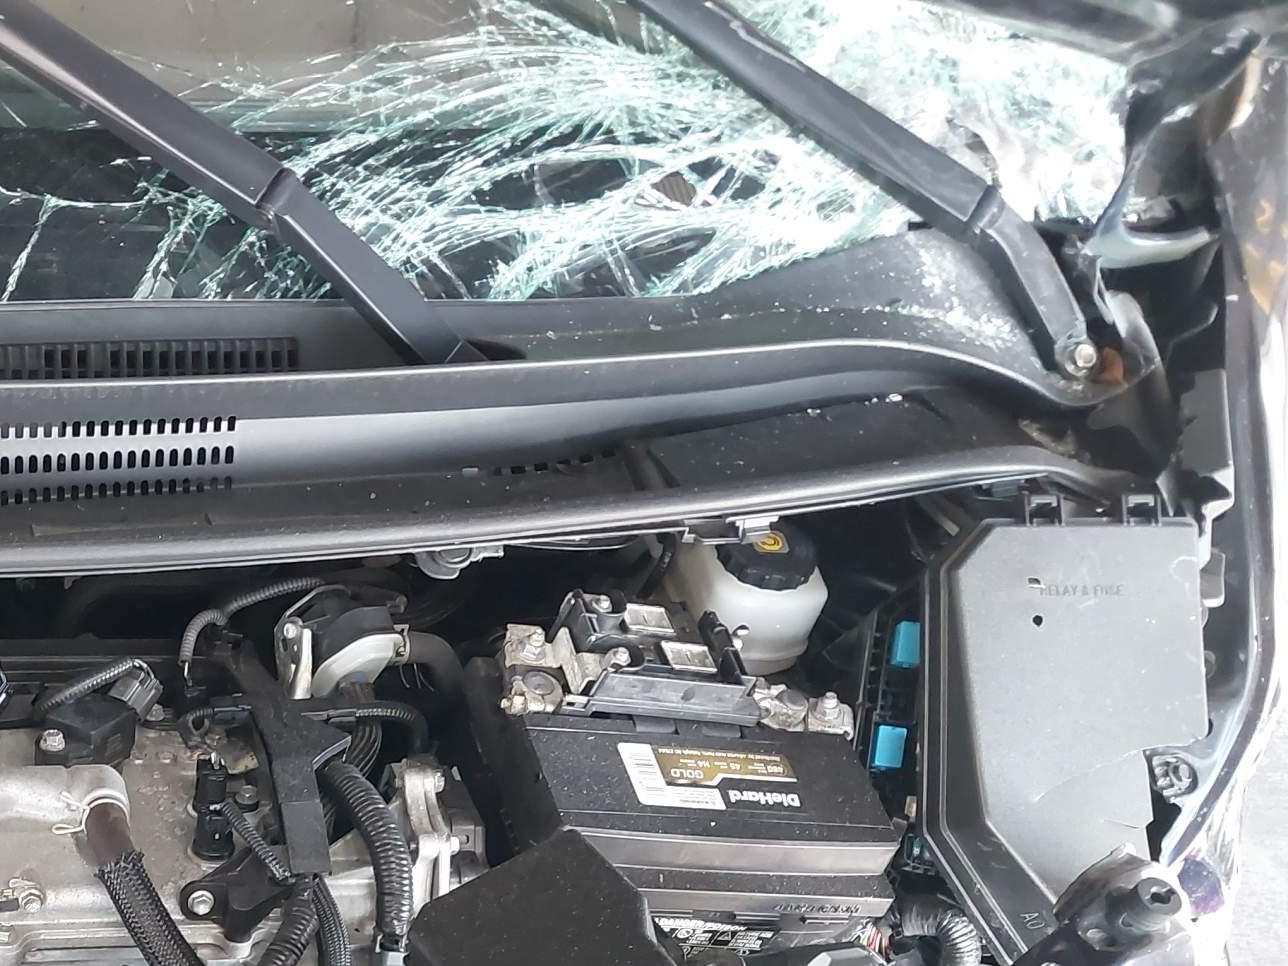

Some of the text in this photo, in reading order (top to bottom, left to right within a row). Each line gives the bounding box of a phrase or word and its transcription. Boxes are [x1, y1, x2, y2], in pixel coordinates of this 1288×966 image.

[1039, 584, 1125, 597] RELAY & FUSE
[671, 768, 704, 779] GOLD
[728, 789, 801, 808] DieHard
